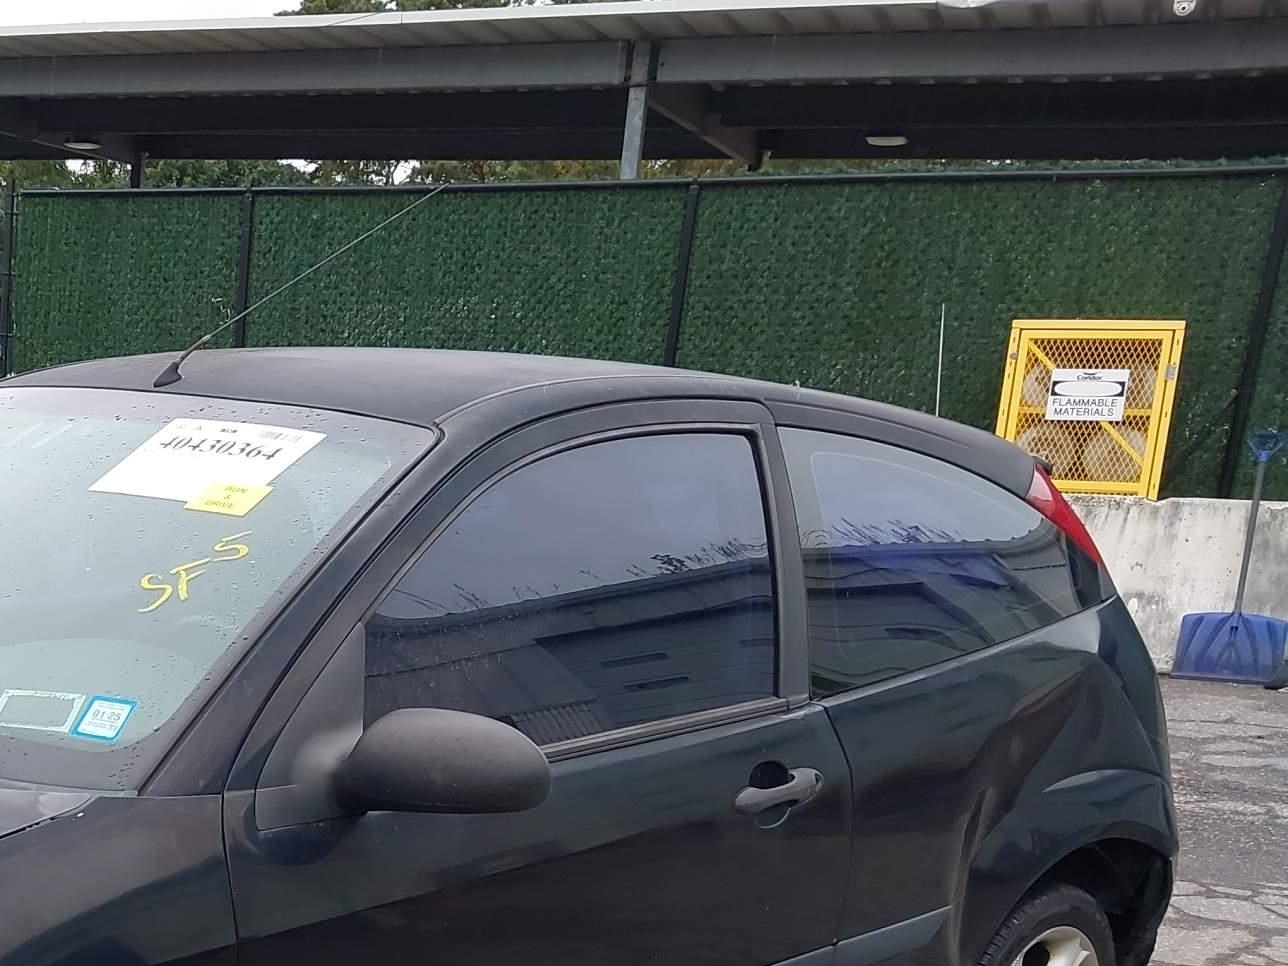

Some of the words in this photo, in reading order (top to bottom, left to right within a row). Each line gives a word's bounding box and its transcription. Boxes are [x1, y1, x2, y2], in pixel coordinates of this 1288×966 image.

[1052, 398, 1118, 408] FLAMMABLE
[1053, 407, 1115, 417] MATERIALS
[160, 435, 284, 461] 40430364
